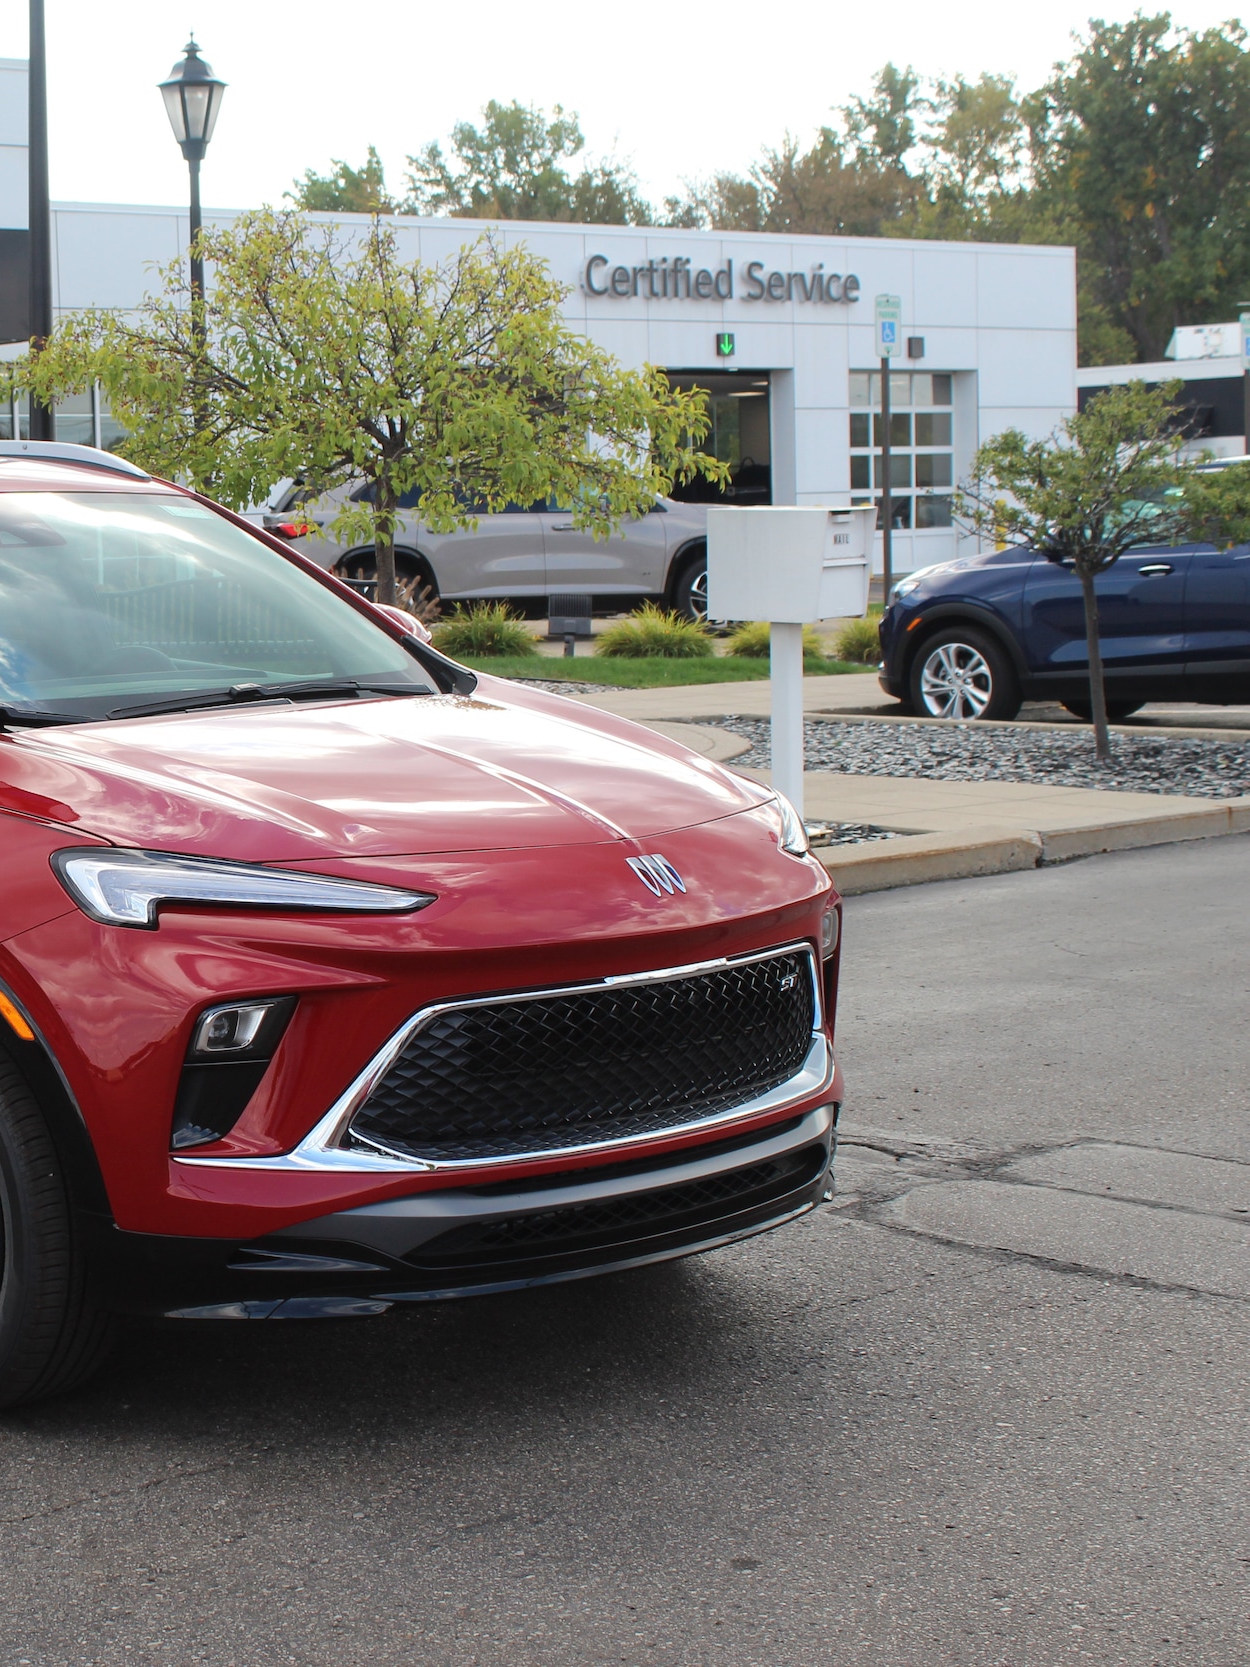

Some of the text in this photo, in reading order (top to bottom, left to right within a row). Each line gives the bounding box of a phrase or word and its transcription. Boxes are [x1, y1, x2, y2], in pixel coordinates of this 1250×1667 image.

[584, 254, 861, 303] Certified Service
[833, 533, 850, 545] MAIL
[780, 973, 798, 991] ST
